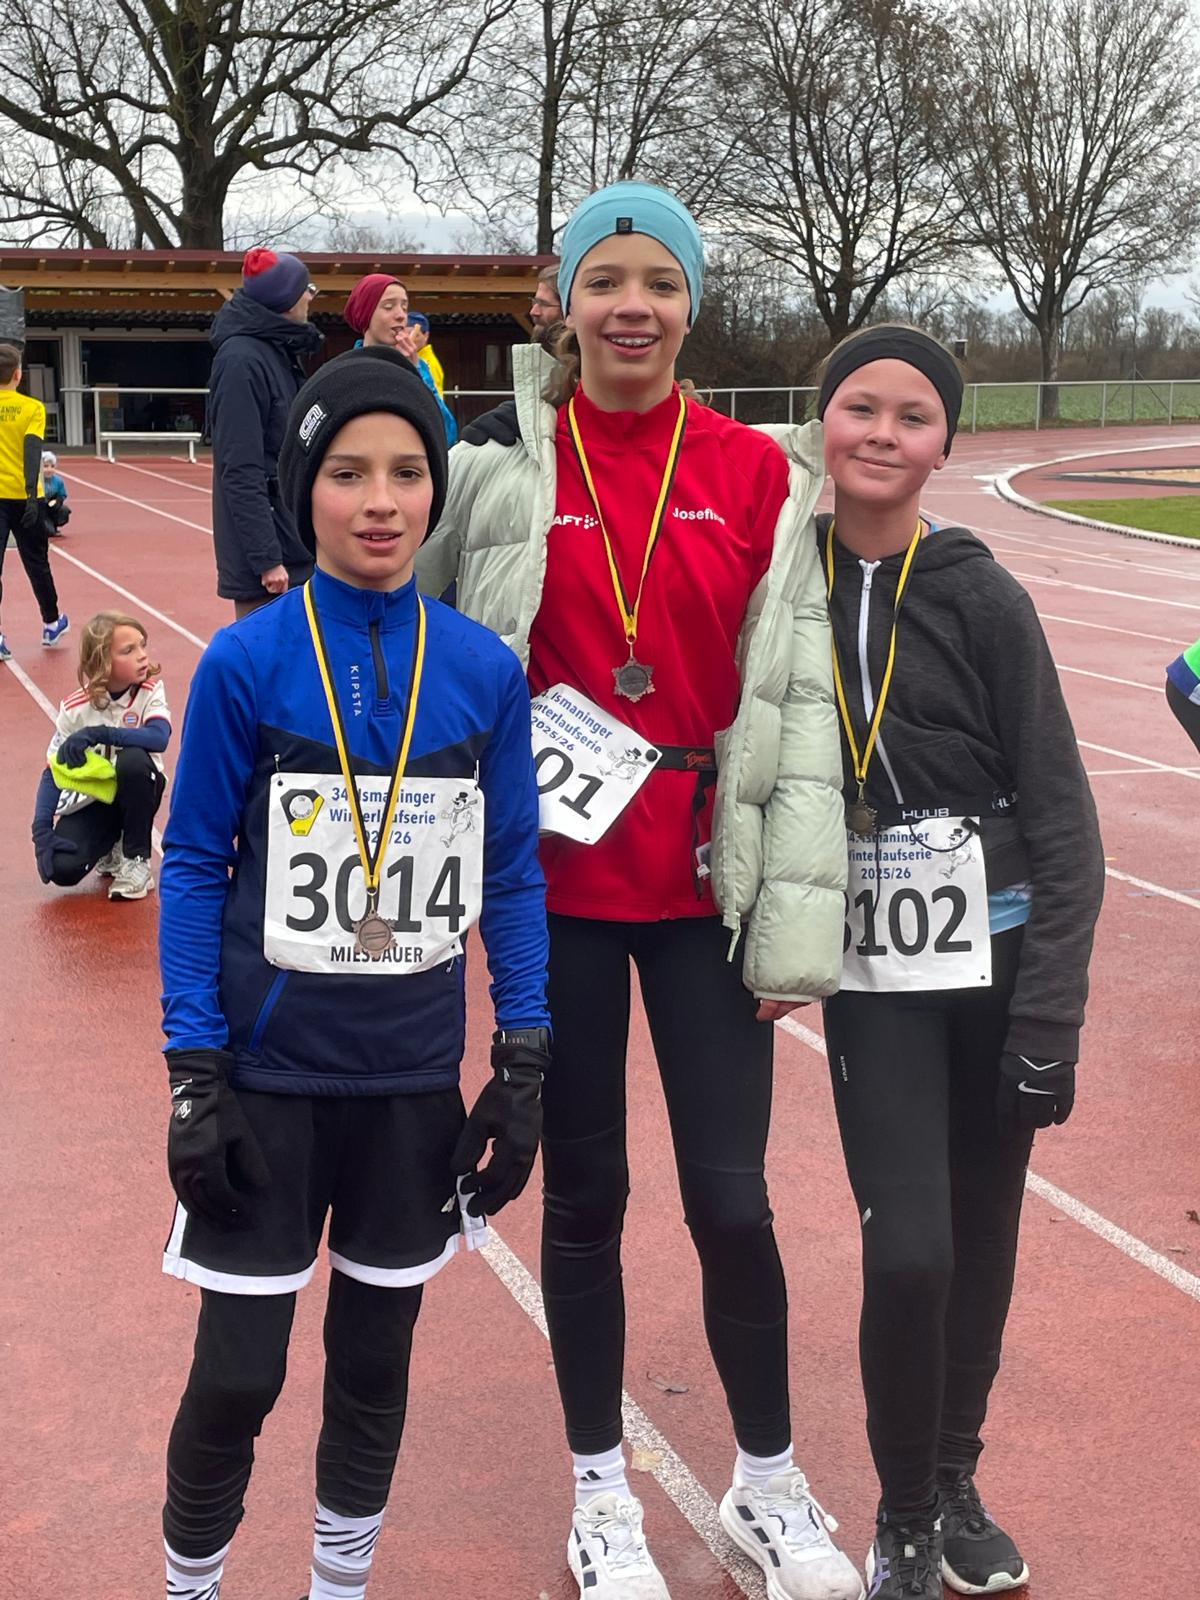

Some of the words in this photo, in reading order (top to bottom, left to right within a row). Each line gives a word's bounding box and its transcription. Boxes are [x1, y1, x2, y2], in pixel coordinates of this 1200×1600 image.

[350, 665, 362, 716] KIPSTA
[531, 701, 602, 754] interlaufserie
[531, 716, 576, 751] 2025/26
[551, 691, 613, 739] Ismaninger
[358, 788, 435, 807] Ismainger
[286, 852, 466, 932] 3014
[330, 946, 423, 963] MIESAUER
